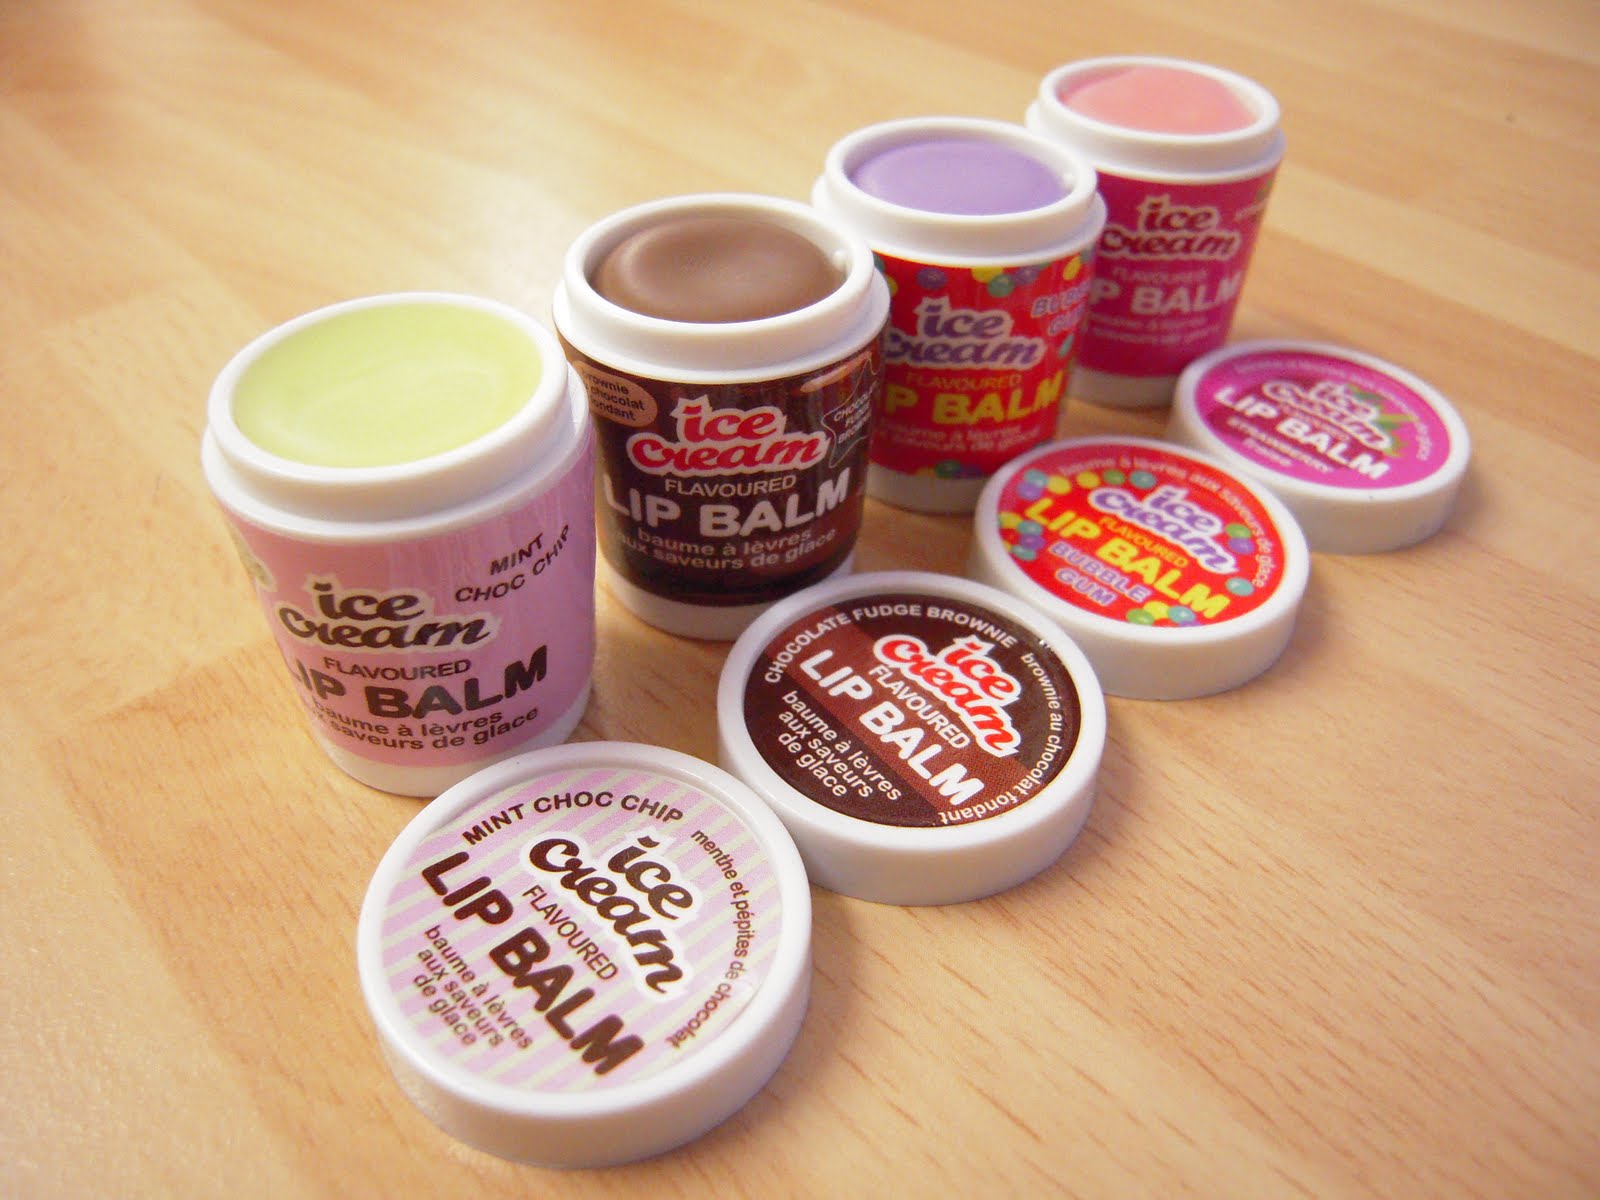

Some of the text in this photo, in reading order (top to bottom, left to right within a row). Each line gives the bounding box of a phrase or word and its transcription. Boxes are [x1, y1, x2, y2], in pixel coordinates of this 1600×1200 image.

[923, 303, 1005, 338] ice
[682, 404, 777, 443] ice
[1214, 386, 1278, 418] LIP
[1276, 417, 1391, 480] BALM
[603, 467, 851, 537] LIP BALM
[665, 475, 797, 498] FLAVOURED
[1150, 488, 1214, 532] ice
[1189, 472, 1222, 494] aux
[1218, 486, 1266, 540] saveurs
[455, 525, 570, 602] CHOC CHIP
[489, 533, 543, 576] MINT
[638, 528, 812, 556] baume à lèvres
[653, 548, 743, 569] saveurs
[752, 553, 778, 568] de
[785, 528, 836, 563] glace
[1024, 498, 1231, 619] LIP BALM
[1049, 541, 1155, 602] BUBBLE
[1099, 517, 1188, 568] FLAVOURED
[1252, 551, 1277, 588] glace
[1258, 536, 1274, 553] de
[312, 582, 424, 621] ice
[1055, 567, 1118, 607] GUM
[323, 656, 472, 680] FLAVOURED
[365, 645, 547, 719] BALM
[948, 641, 1015, 702] ice
[331, 708, 538, 750] saveurs de glace
[398, 723, 413, 737] à
[422, 711, 503, 738] lèvres
[765, 604, 1064, 826] CHOCOLATE FUDGE BROWNIE brownie au chocolat fondant
[799, 649, 986, 806] LIP BALM
[868, 664, 972, 750] FLAVOURED
[778, 732, 849, 799] de glace
[779, 710, 874, 800] aux saveurs
[781, 691, 903, 802] baume à lèvres
[462, 791, 684, 846] MINT CHOC CHIP
[608, 835, 694, 921] ice
[421, 851, 644, 1076] LIP BALM
[522, 885, 618, 981] FLAVOURED
[664, 828, 756, 1049] menthe et pépites de chocolat
[414, 972, 478, 1045] de glace
[417, 946, 505, 1048] aux saveurs
[424, 923, 534, 1050] baume à lèvres
